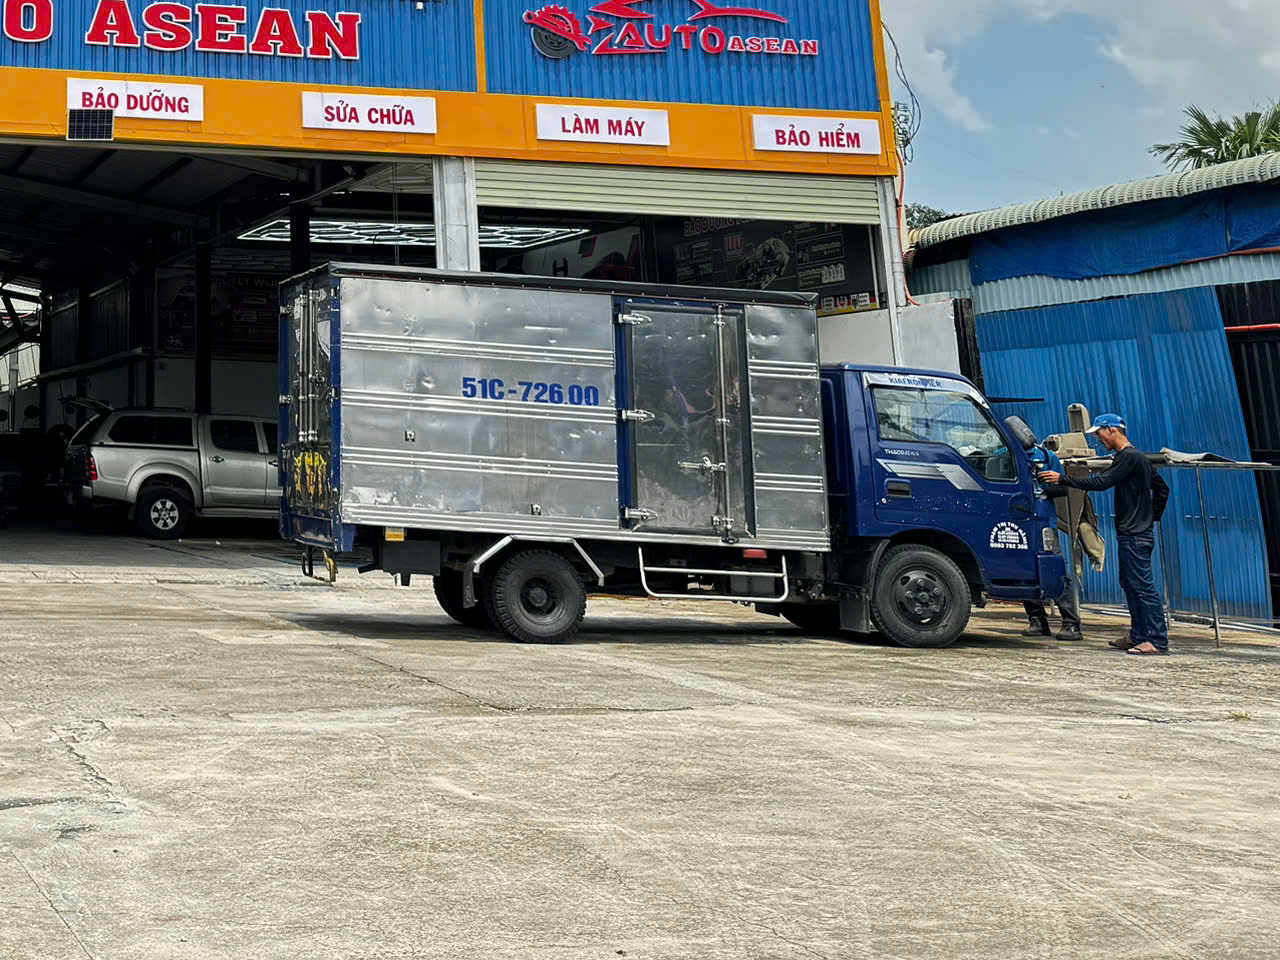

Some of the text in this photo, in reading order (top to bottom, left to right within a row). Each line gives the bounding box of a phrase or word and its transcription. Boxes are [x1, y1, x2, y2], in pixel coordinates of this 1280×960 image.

[727, 35, 819, 56] ASEAN
[81, 87, 190, 113] BẢO DƯỠNG
[324, 100, 415, 126] SỬA CHỮA
[561, 111, 645, 137] LÀM MÁY
[775, 122, 861, 148] BẢO HIỂM
[462, 377, 600, 406] 51C-726.00
